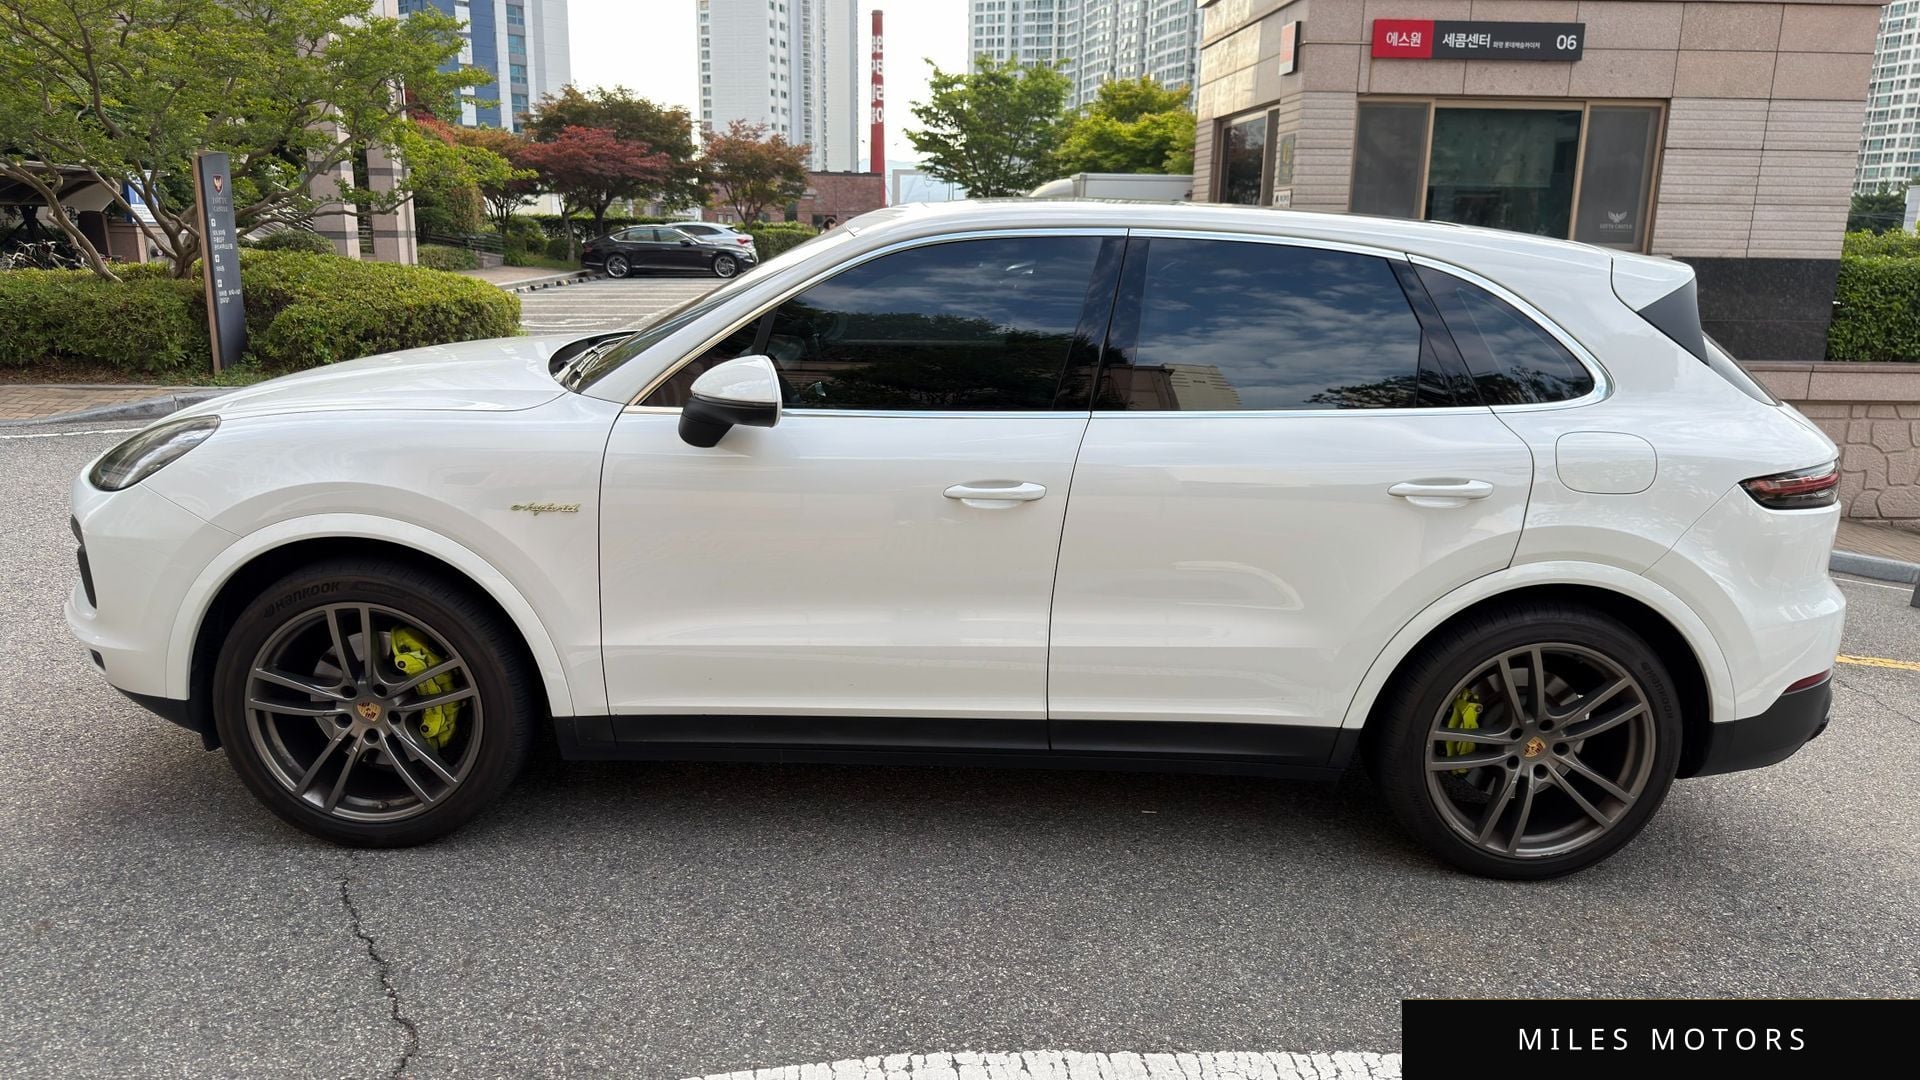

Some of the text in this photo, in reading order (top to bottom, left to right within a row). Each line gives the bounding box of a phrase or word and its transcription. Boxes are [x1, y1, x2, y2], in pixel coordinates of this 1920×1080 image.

[1386, 31, 1422, 47] 에스원
[1442, 32, 1491, 48] 세콤센터
[1556, 34, 1577, 50] 06
